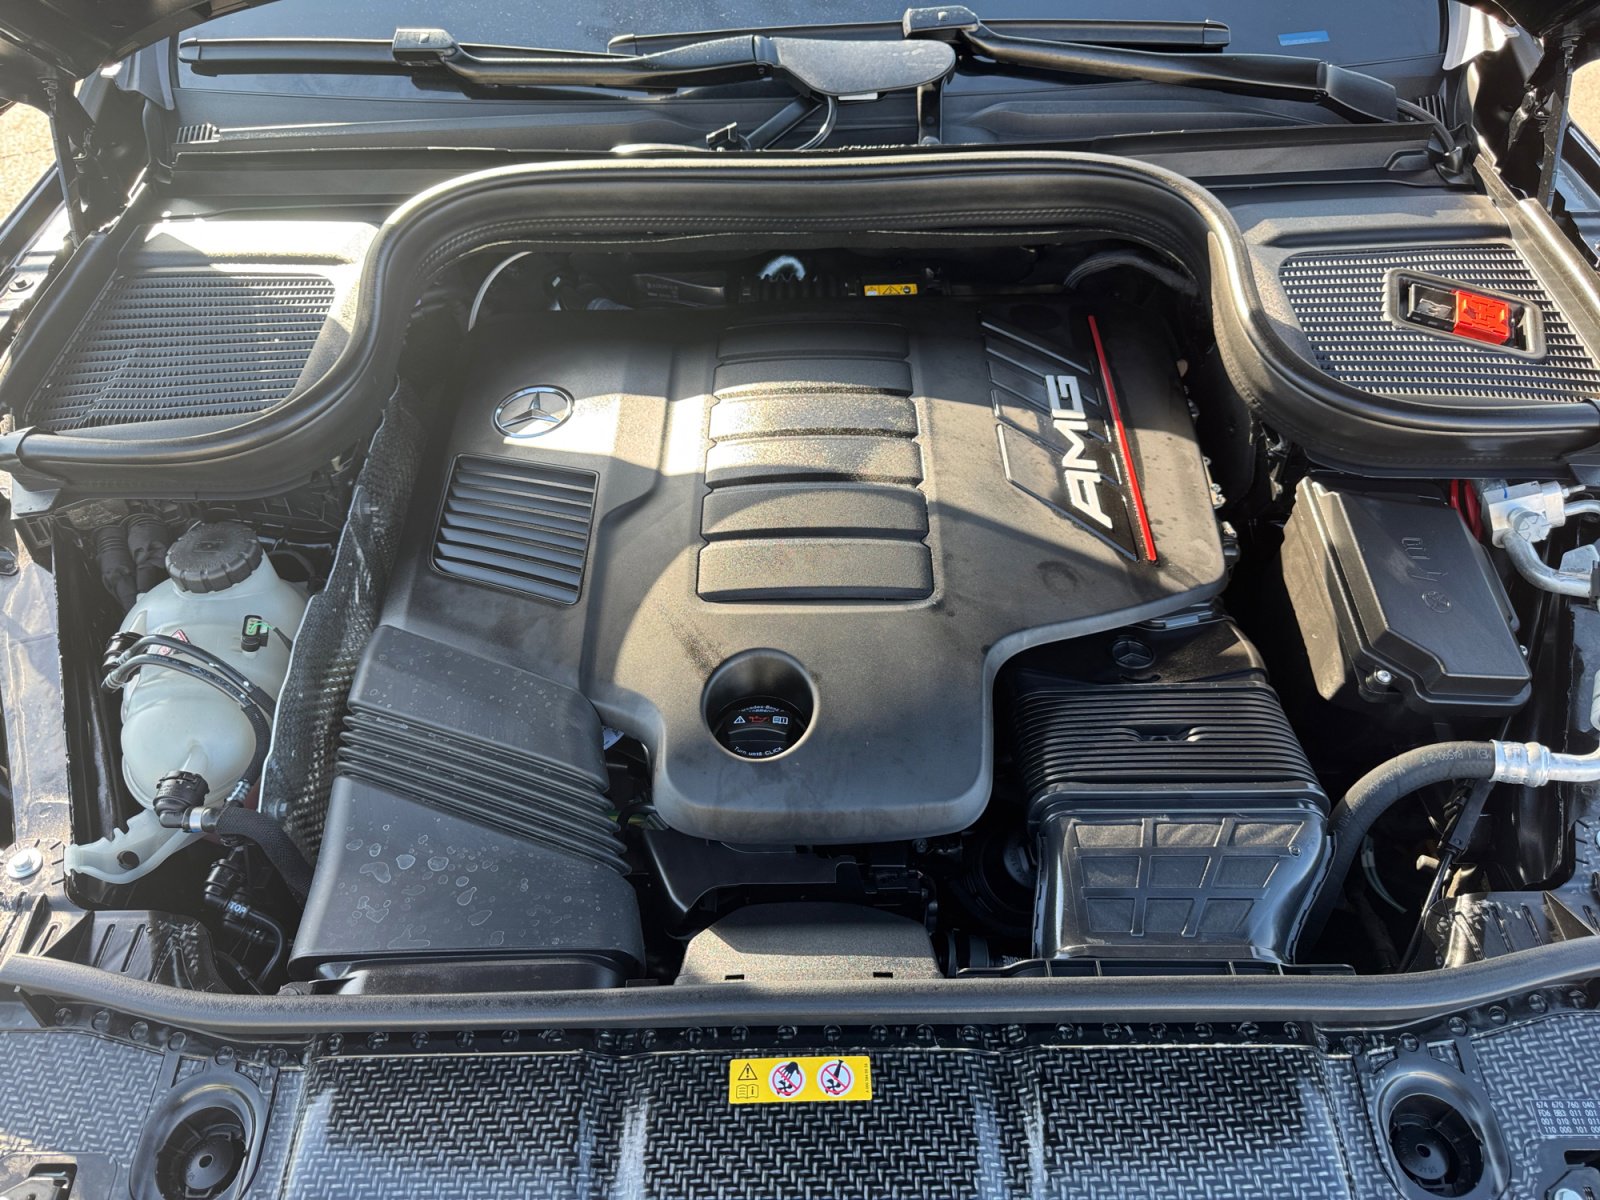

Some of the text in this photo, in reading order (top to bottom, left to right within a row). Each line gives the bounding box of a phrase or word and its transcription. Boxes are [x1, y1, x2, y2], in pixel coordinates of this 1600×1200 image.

[1045, 374, 1114, 530] AMG
[734, 746, 747, 755] Turn
[764, 746, 783, 756] CLICK
[229, 901, 247, 914] TOP
[1569, 1109, 1582, 1117] 011
[1585, 1109, 1598, 1117] 001
[1544, 1126, 1557, 1134] 110
[1559, 1126, 1572, 1134] 000
